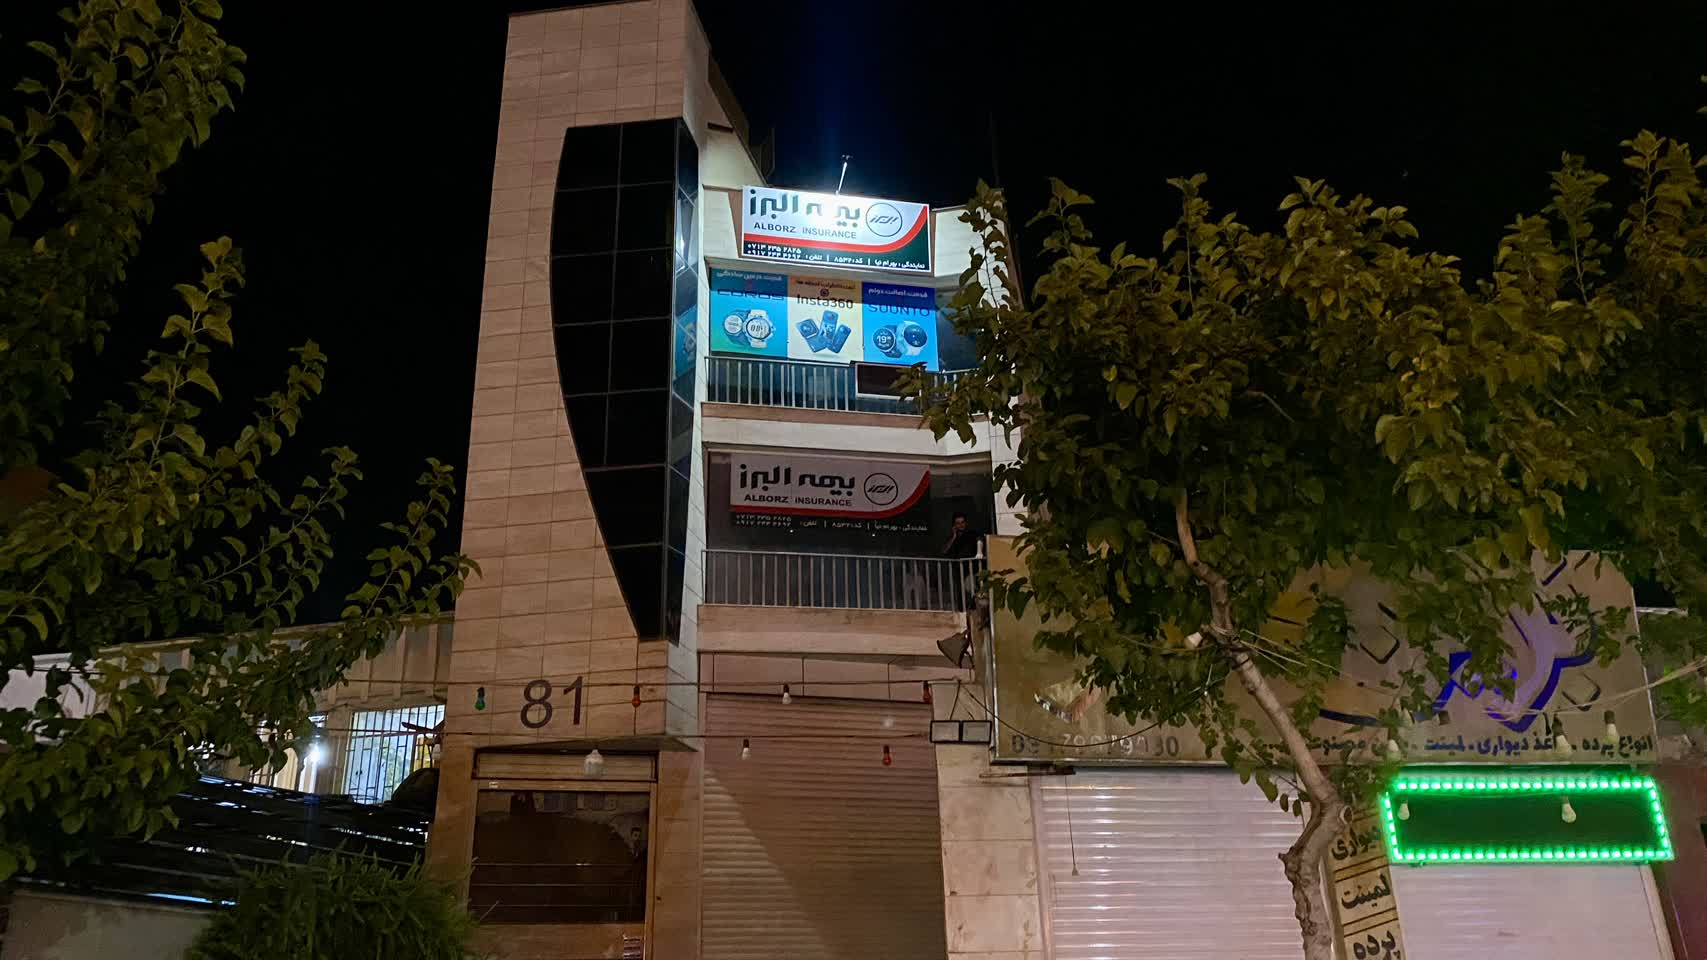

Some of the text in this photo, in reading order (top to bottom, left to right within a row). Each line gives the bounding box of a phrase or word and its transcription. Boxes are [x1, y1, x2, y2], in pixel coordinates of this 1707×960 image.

[749, 189, 861, 228] بیه البرز
[753, 221, 857, 239] ALBORZ INSURANCE
[796, 294, 854, 309] Insta360
[868, 303, 930, 317] SUUNTO
[740, 463, 856, 496] بیمه البرز
[744, 493, 853, 507] ALBORZ INSURANCE
[520, 675, 583, 729] 81
[1477, 735, 1530, 757] دیواری
[1582, 737, 1614, 758] پرده
[1618, 735, 1653, 758] انواع
[1341, 873, 1391, 910] لمینت
[1353, 930, 1401, 960] پرده
